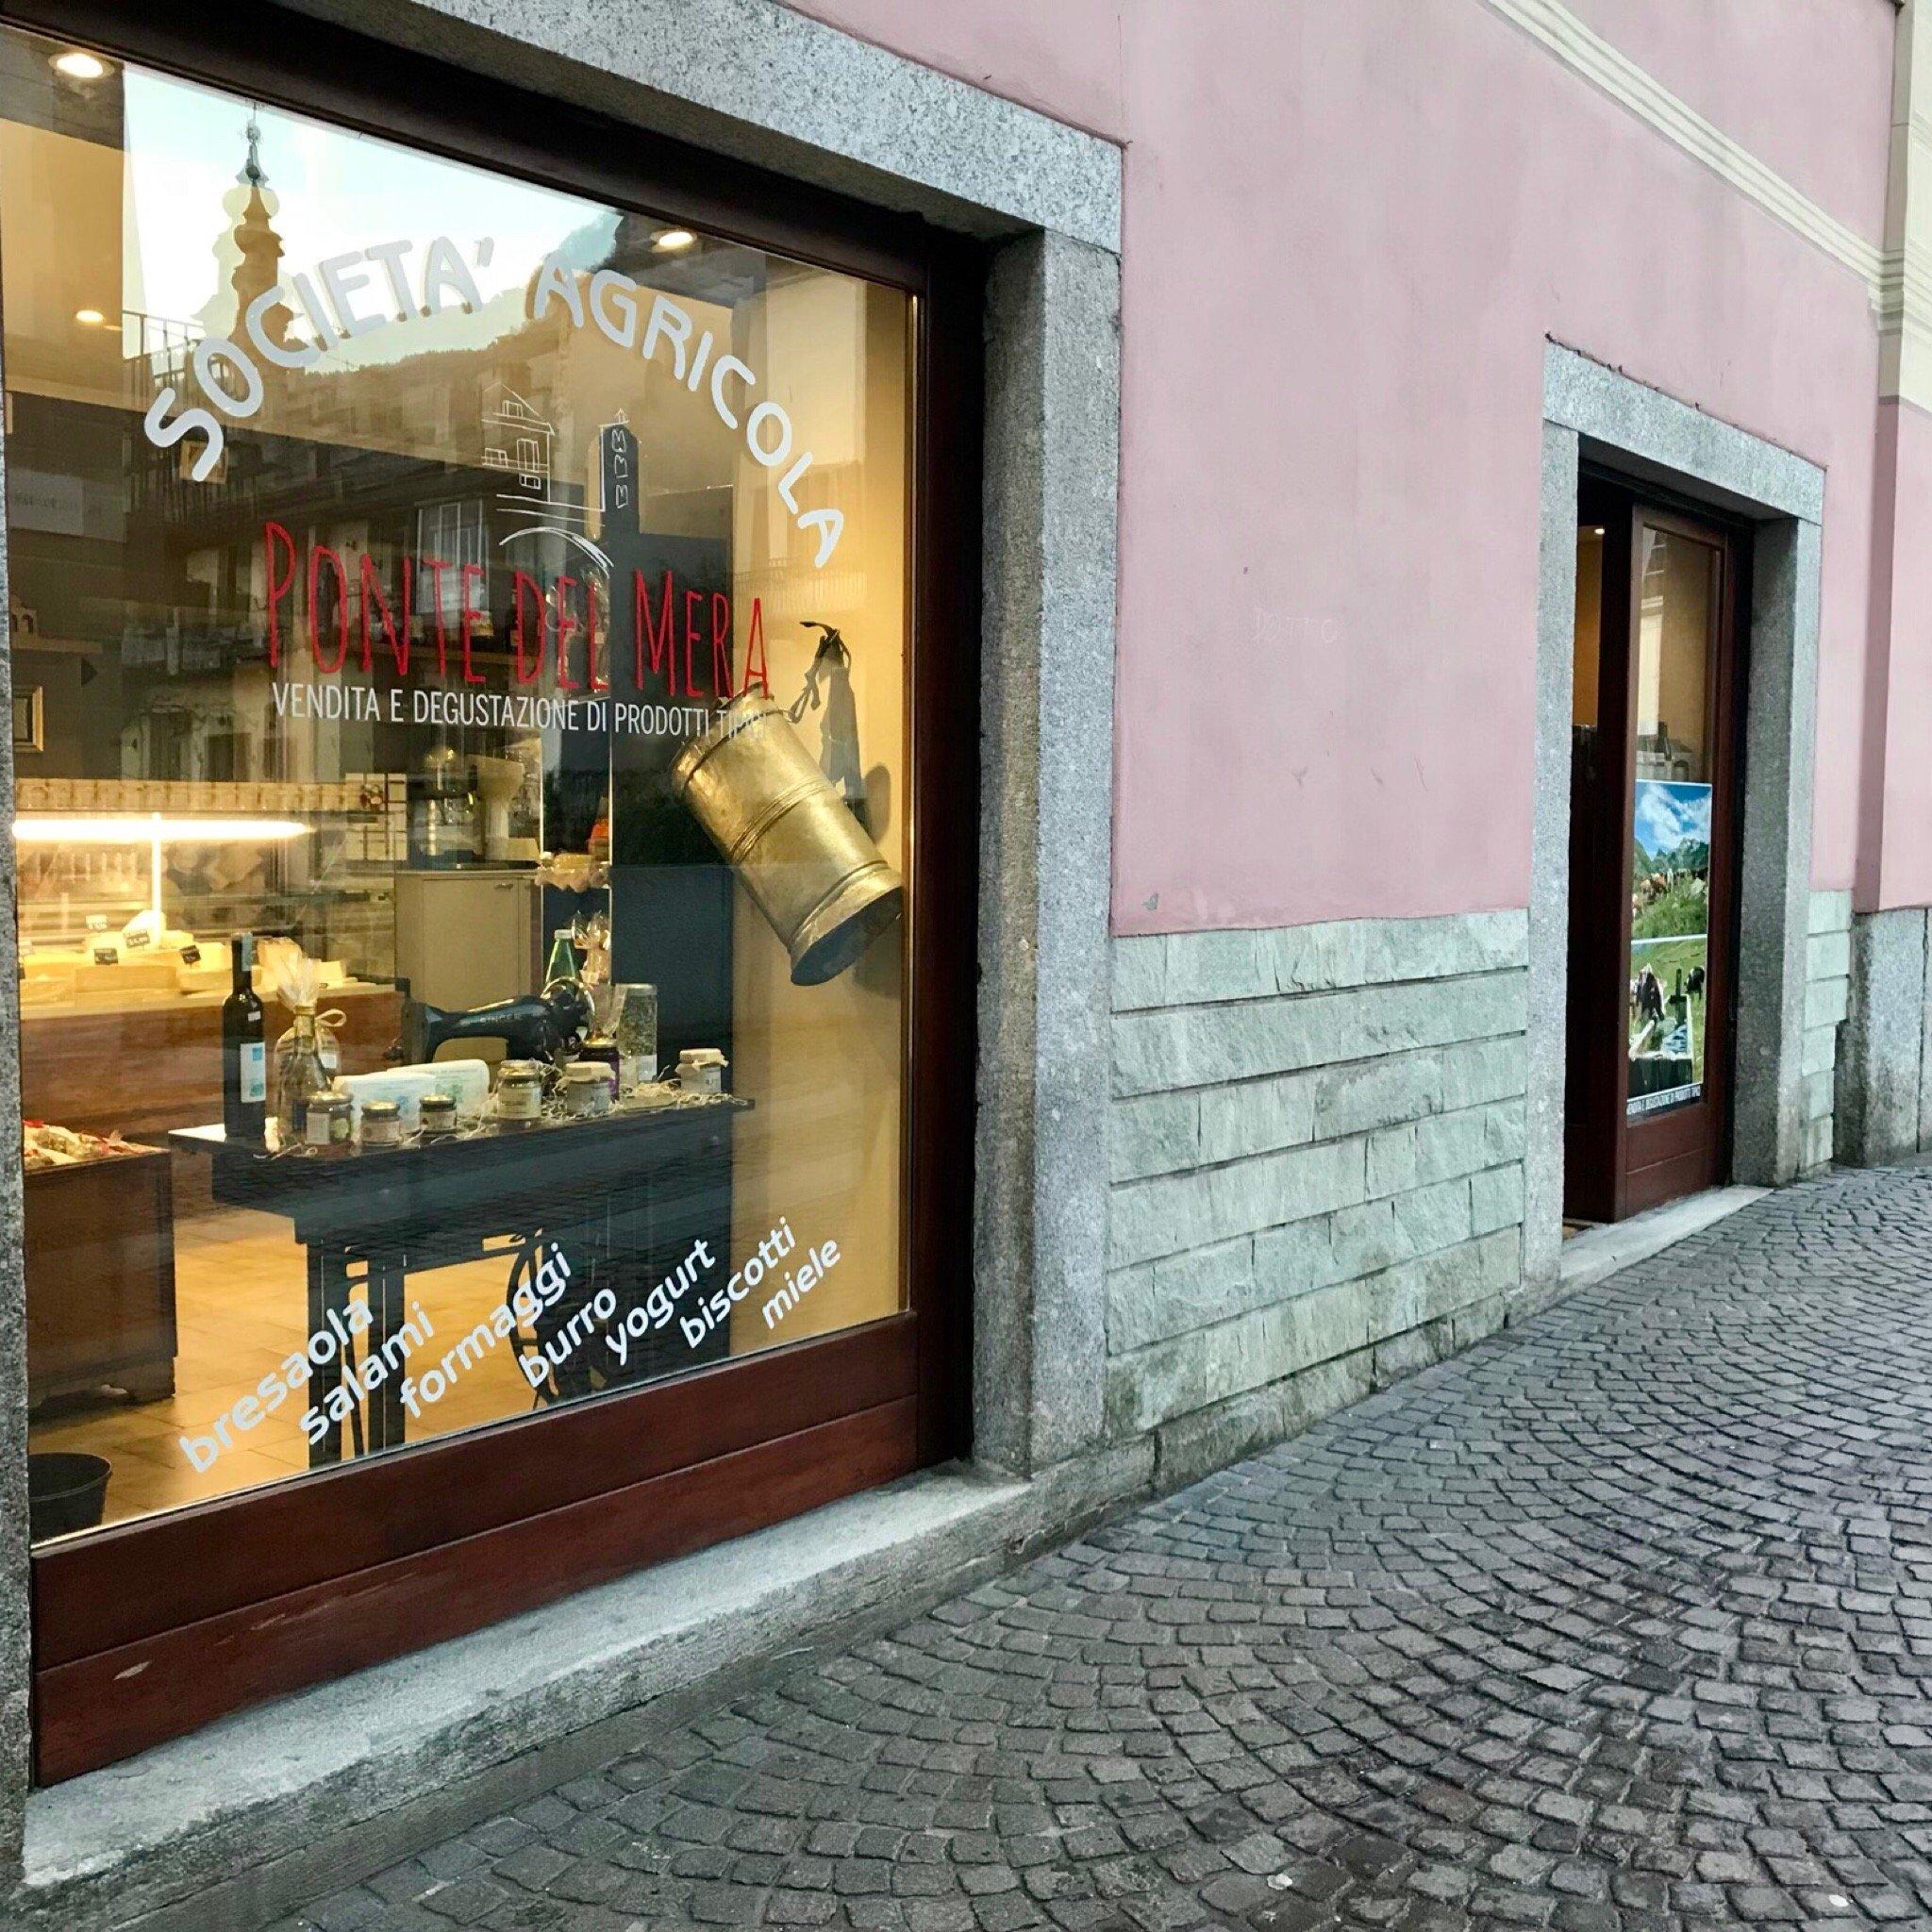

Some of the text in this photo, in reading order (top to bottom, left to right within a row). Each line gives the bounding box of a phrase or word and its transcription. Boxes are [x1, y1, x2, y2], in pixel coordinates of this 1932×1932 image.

[533, 252, 845, 569] AGRICOLA
[264, 521, 770, 701] PONTE DEL MERA
[272, 681, 380, 722] VENDITA
[391, 689, 404, 723] E
[414, 691, 579, 731] DEGUSTAZIONE
[587, 701, 607, 732] DI
[615, 703, 709, 738] PRODOTTI
[400, 1242, 573, 1419] formaggi
[518, 1288, 618, 1389] burro
[605, 1238, 717, 1365] yogurt
[679, 1217, 799, 1349] biscotti
[762, 1237, 841, 1330] miele
[179, 1293, 375, 1474] bresaola
[298, 1301, 435, 1445] salami
